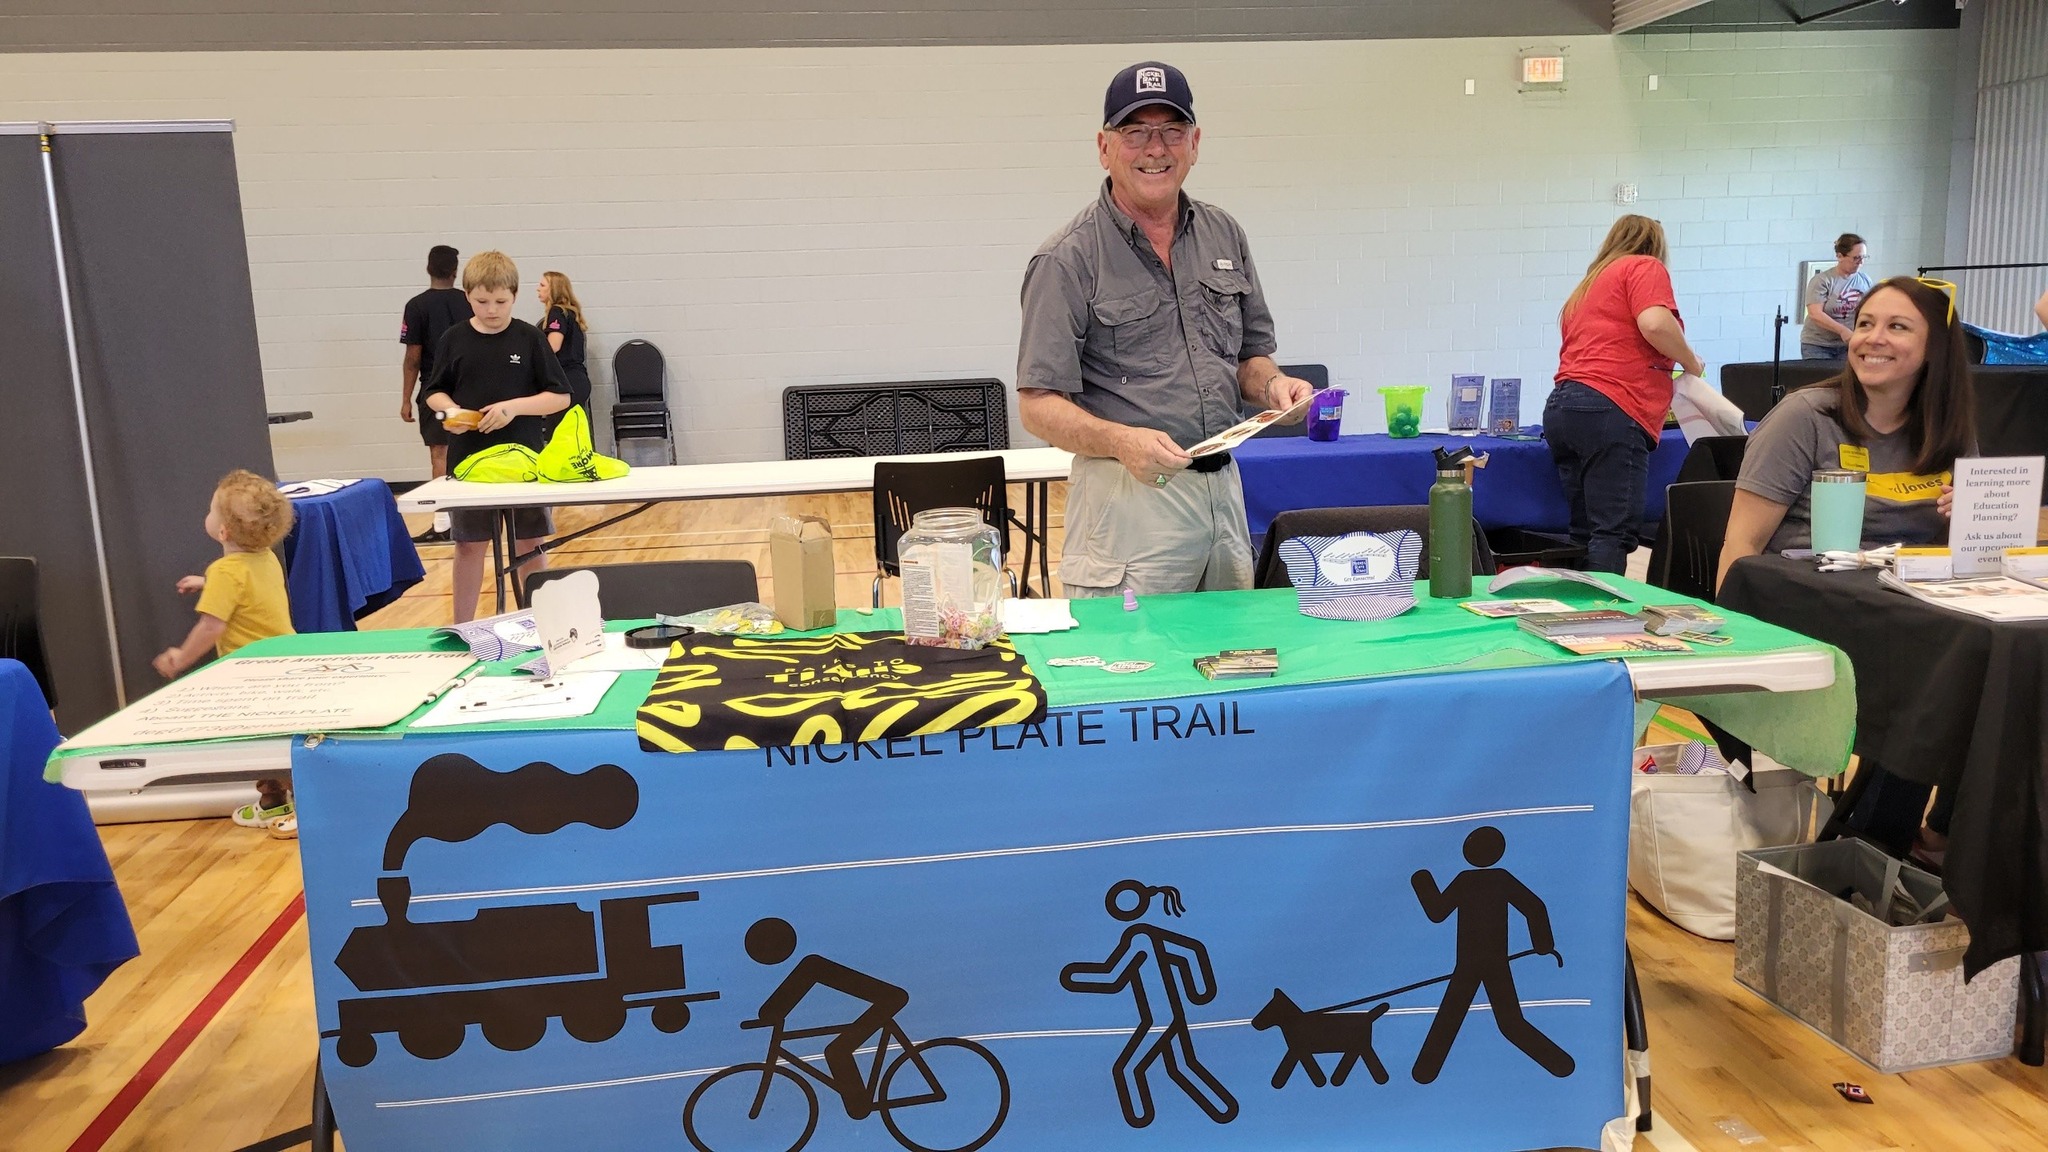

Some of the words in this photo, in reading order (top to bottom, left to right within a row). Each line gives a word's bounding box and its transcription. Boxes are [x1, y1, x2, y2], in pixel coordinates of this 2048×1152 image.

[1532, 59, 1558, 80] EXIT
[1970, 466, 2017, 476] Interested
[2019, 466, 2029, 475] in
[1902, 478, 1943, 495] Jones
[1966, 479, 2005, 488] learning
[1984, 490, 2010, 498] about
[1973, 501, 2019, 510] Education
[1972, 513, 2018, 522] Planning?
[1965, 532, 1981, 540] Ask
[1996, 532, 2022, 540] about
[291, 655, 381, 663] American
[765, 734, 943, 767] NICKEL
[958, 709, 1106, 753] PLATE
[1119, 701, 1255, 742] TRAIL
